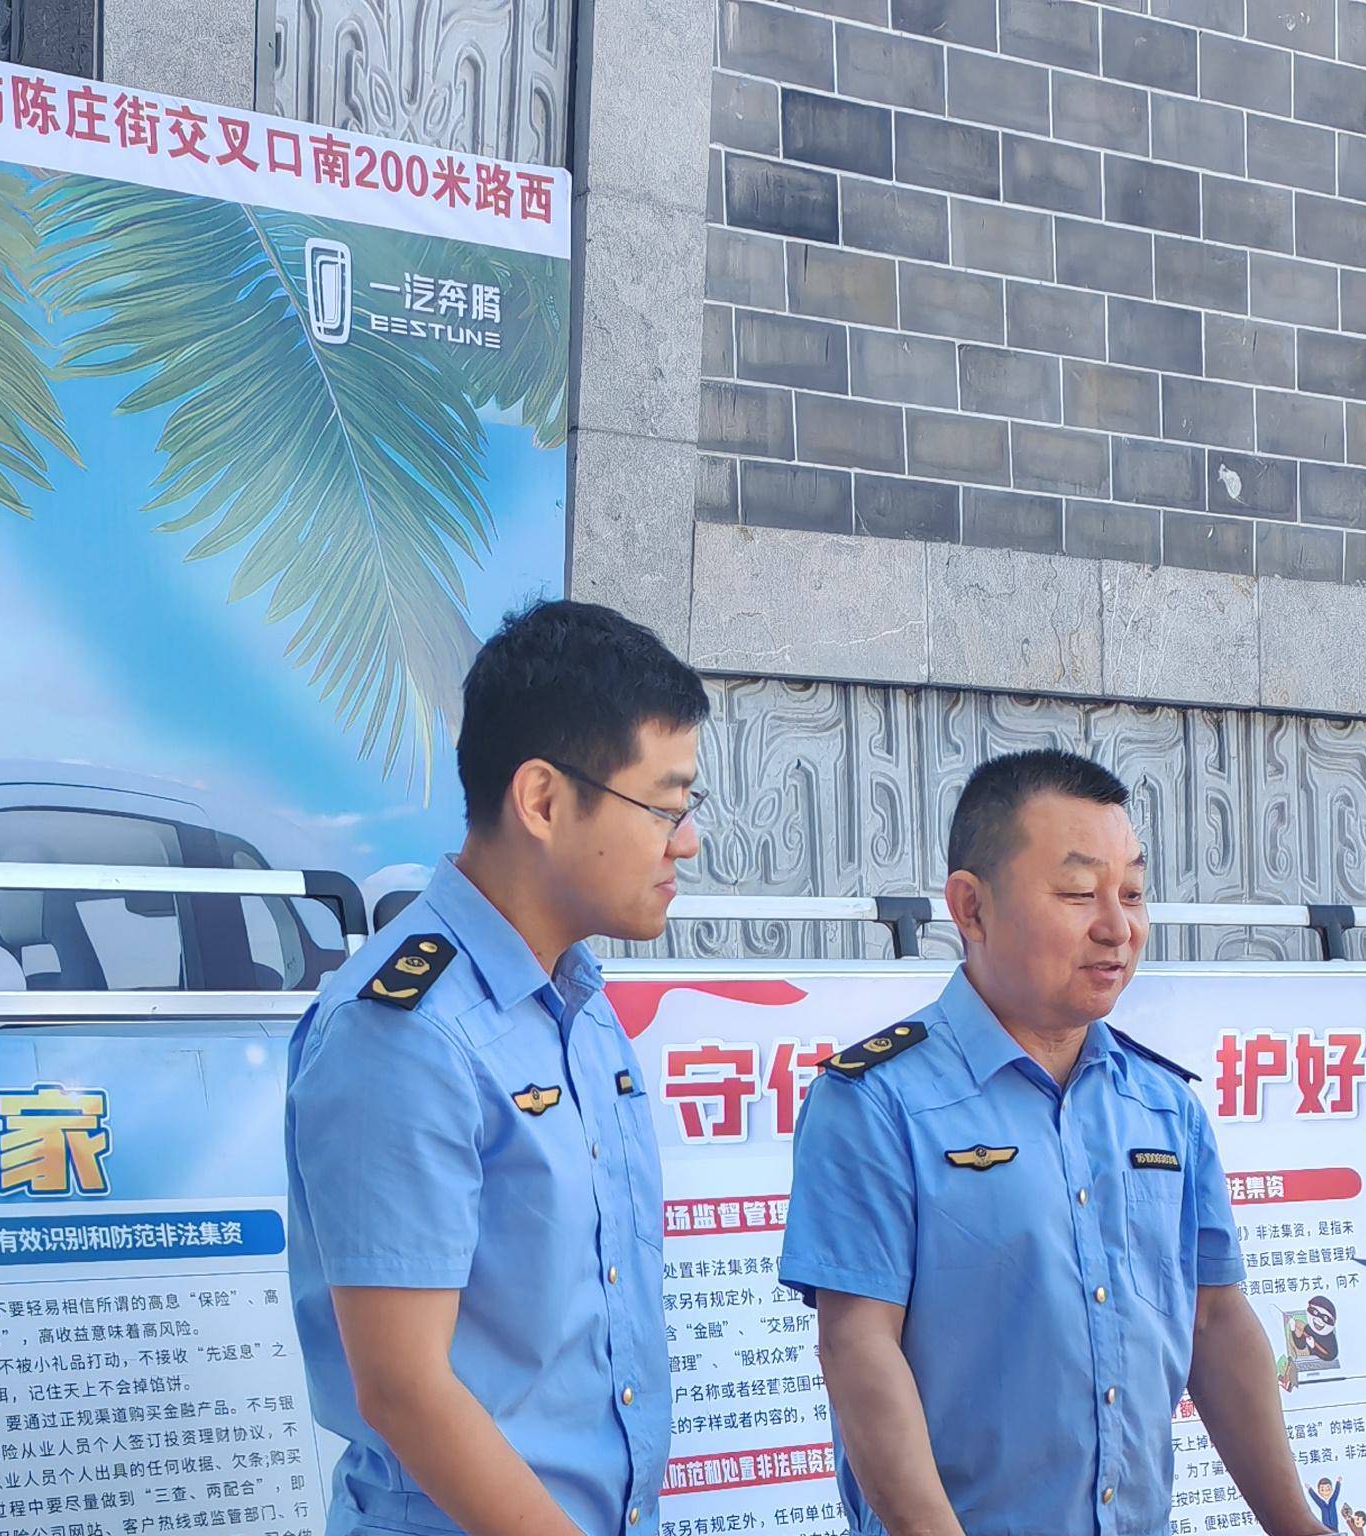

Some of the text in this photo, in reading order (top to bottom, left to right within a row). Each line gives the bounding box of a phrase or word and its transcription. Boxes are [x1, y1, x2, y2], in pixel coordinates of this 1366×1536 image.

[369, 271, 502, 323] 一汽奔腾
[370, 314, 502, 349] BESTUNE
[664, 1256, 782, 1280] 处置非法集资条
[1172, 1435, 1215, 1452] 天上掉
